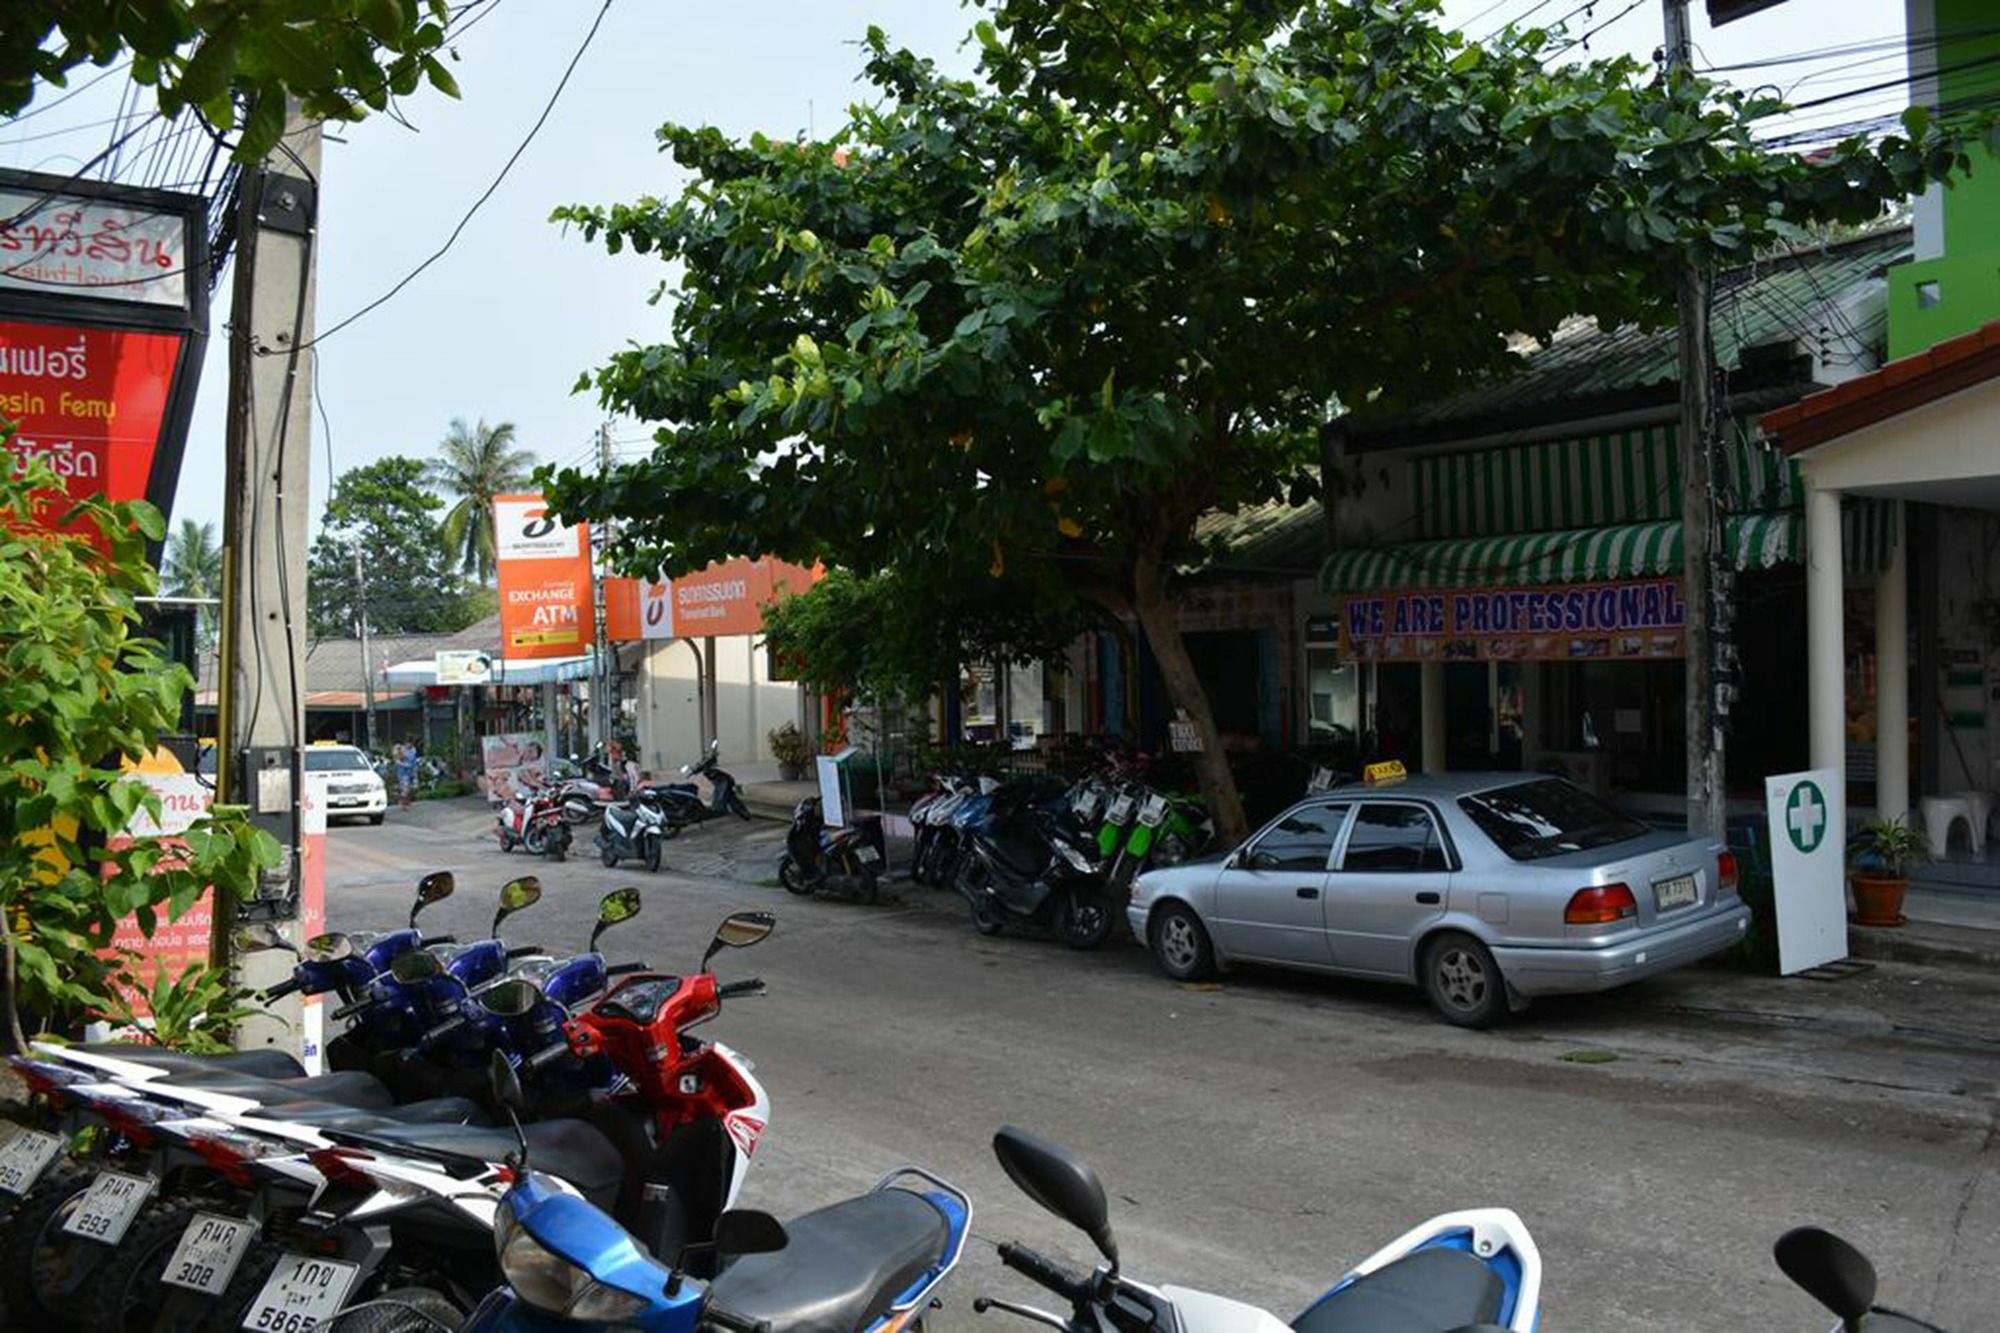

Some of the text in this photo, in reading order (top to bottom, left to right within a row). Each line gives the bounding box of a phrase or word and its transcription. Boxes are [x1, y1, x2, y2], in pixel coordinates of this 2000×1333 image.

[508, 589, 575, 603] EXCHANGE
[533, 604, 578, 625] ATM
[1348, 583, 1687, 636] WE ARE PROFESSIONAL
[77, 1213, 111, 1236] 293
[177, 1262, 214, 1287] 308
[257, 1307, 318, 1333] 5865
